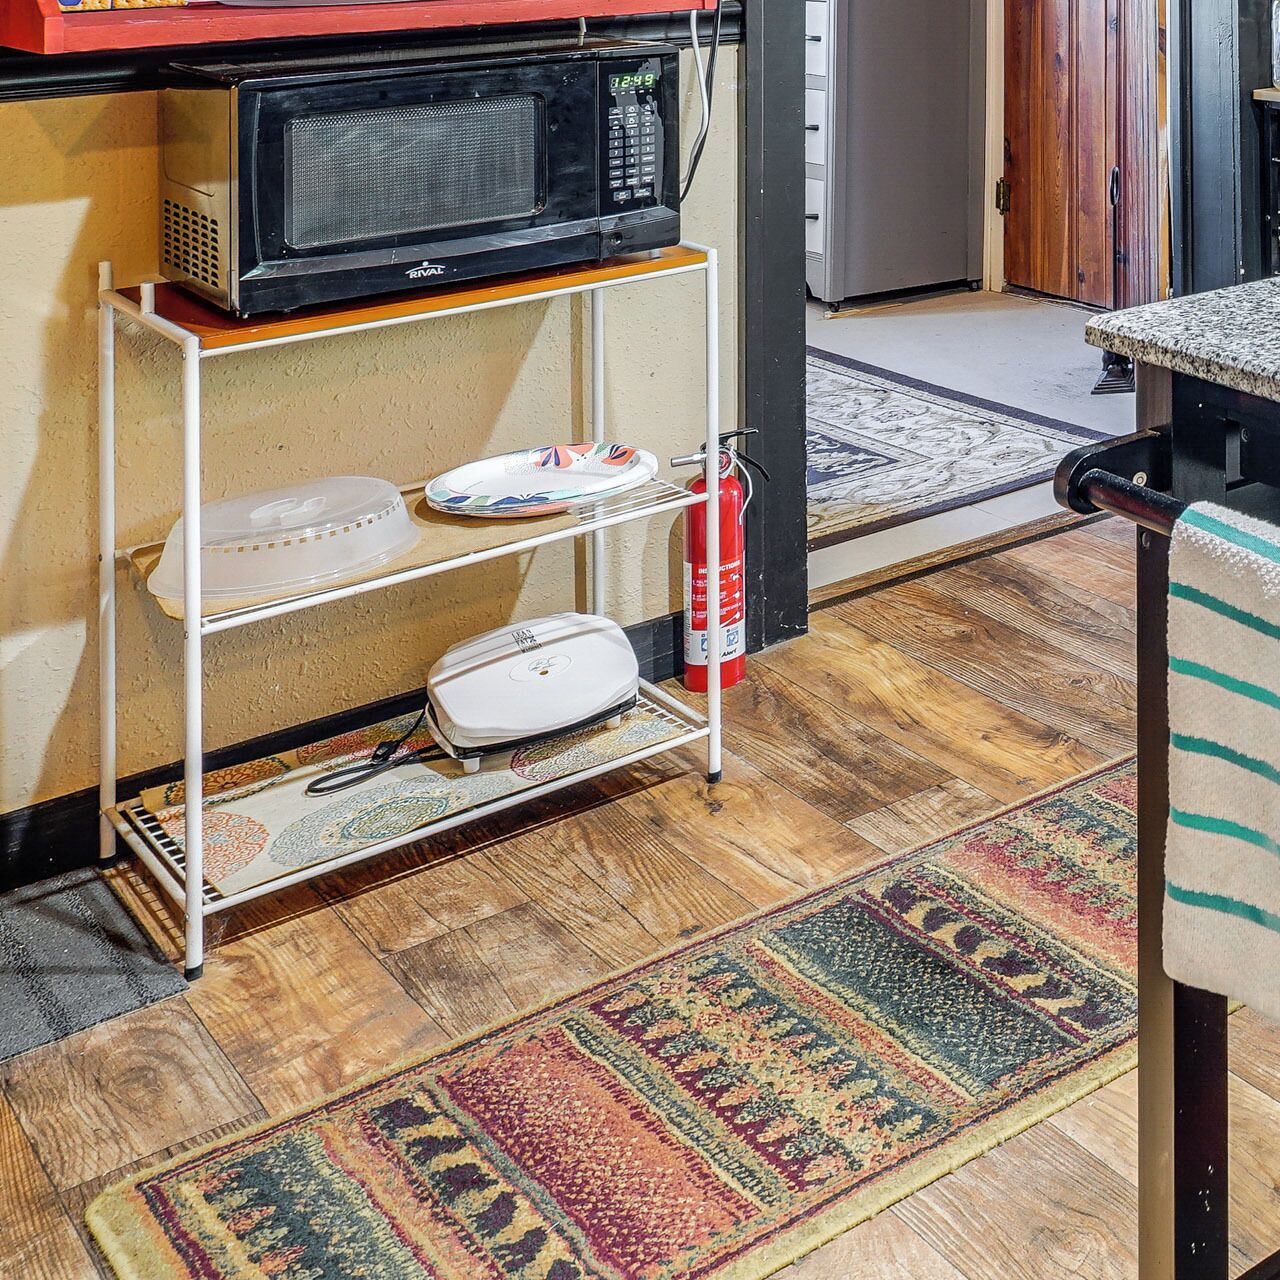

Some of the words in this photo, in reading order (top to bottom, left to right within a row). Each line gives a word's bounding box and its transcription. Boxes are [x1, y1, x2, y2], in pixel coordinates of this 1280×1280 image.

[611, 74, 654, 88] 12:49
[410, 268, 444, 278] RIVAL
[721, 649, 737, 658] Alert
